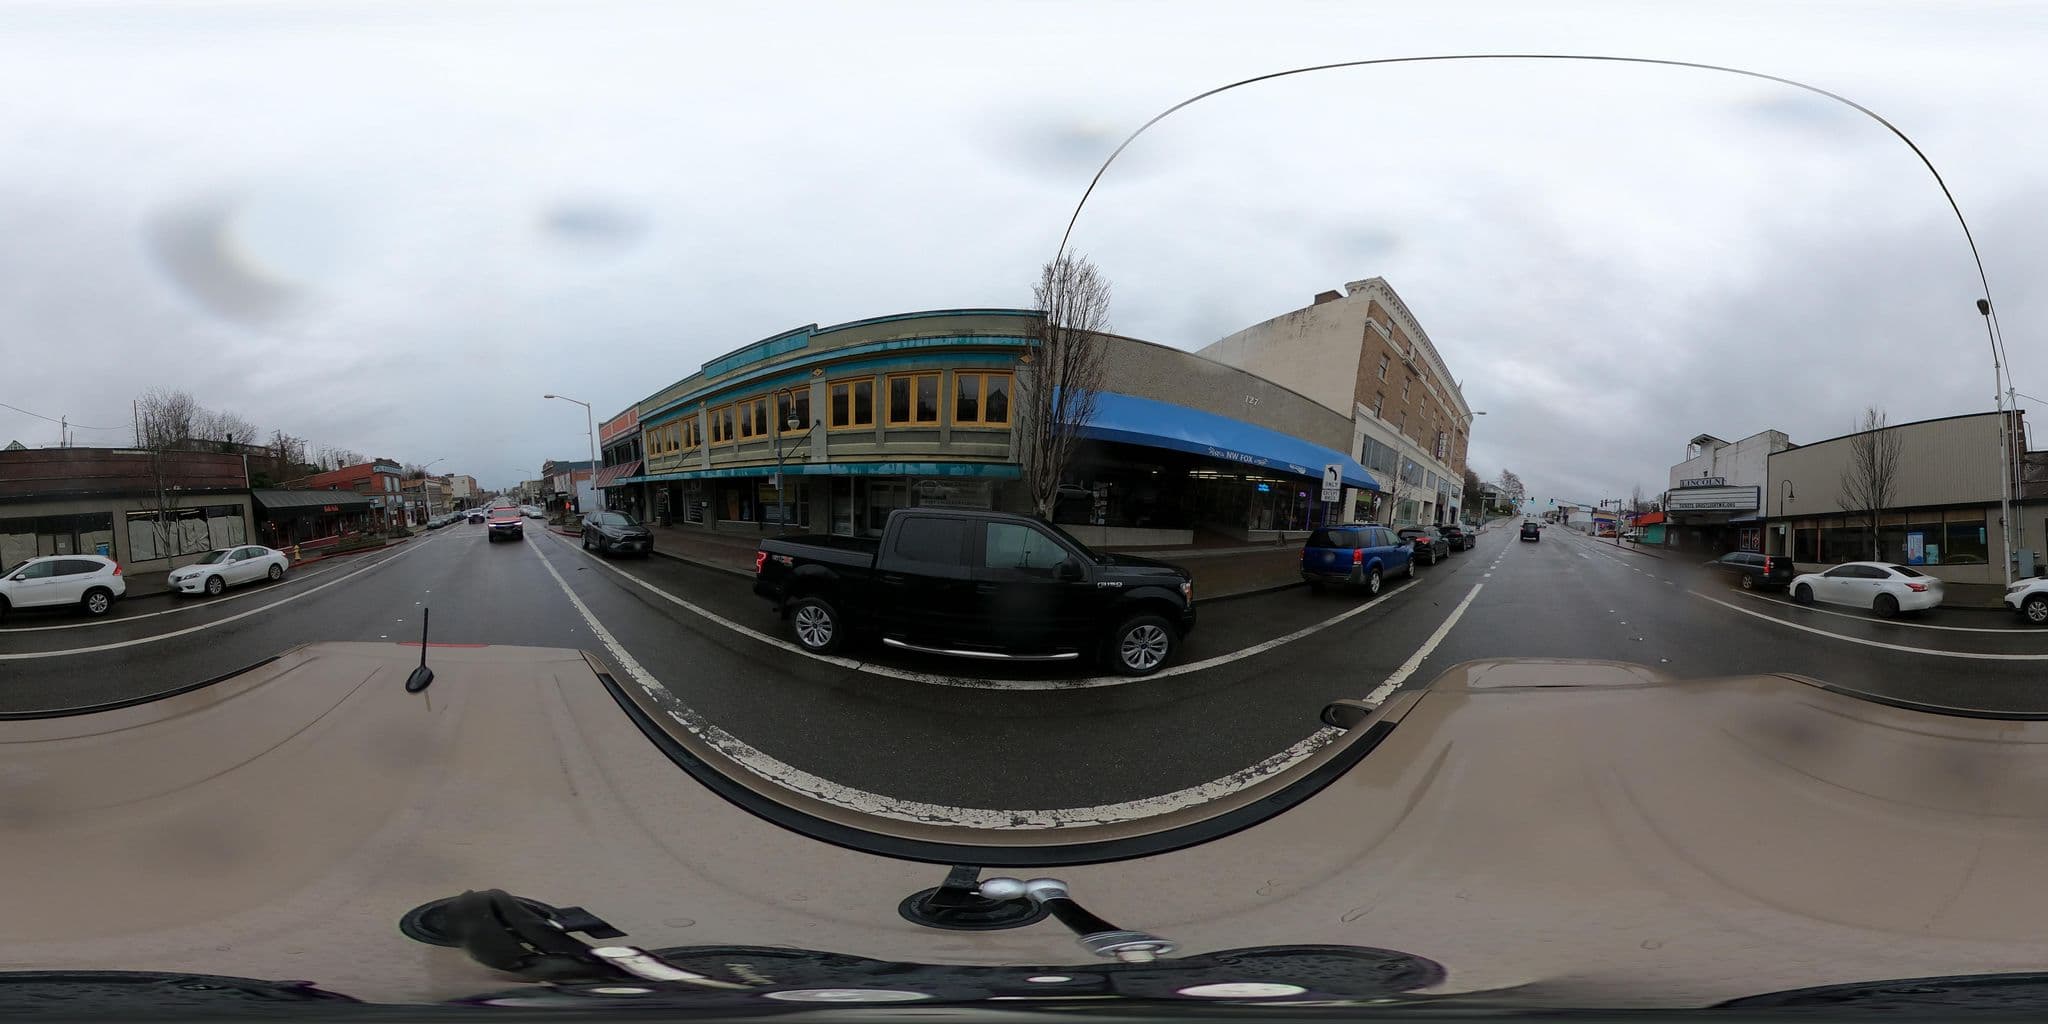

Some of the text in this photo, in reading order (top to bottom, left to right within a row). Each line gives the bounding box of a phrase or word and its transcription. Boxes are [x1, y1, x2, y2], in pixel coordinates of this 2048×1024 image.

[1226, 451, 1240, 460] NW
[1240, 454, 1254, 464] FOX
[1681, 478, 1723, 488] LINCOLN
